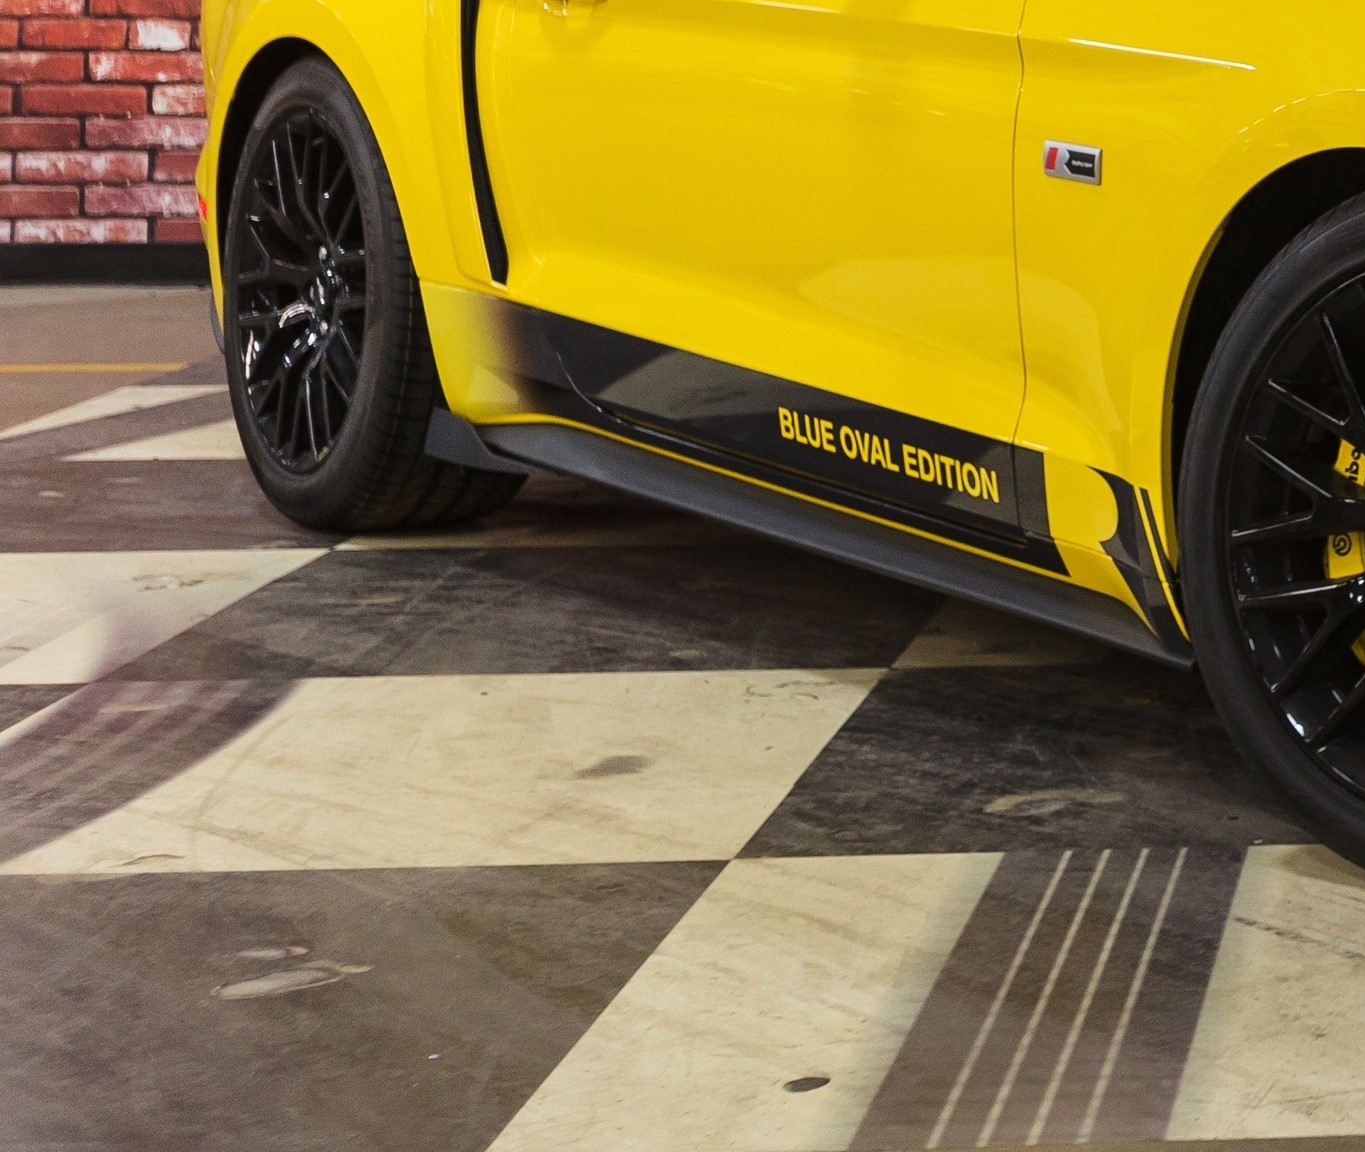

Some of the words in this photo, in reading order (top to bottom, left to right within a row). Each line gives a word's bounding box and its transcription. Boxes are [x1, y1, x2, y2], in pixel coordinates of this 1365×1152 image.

[777, 405, 837, 454] BLUE
[839, 424, 900, 473] OVAL
[902, 443, 1000, 504] EDITION
